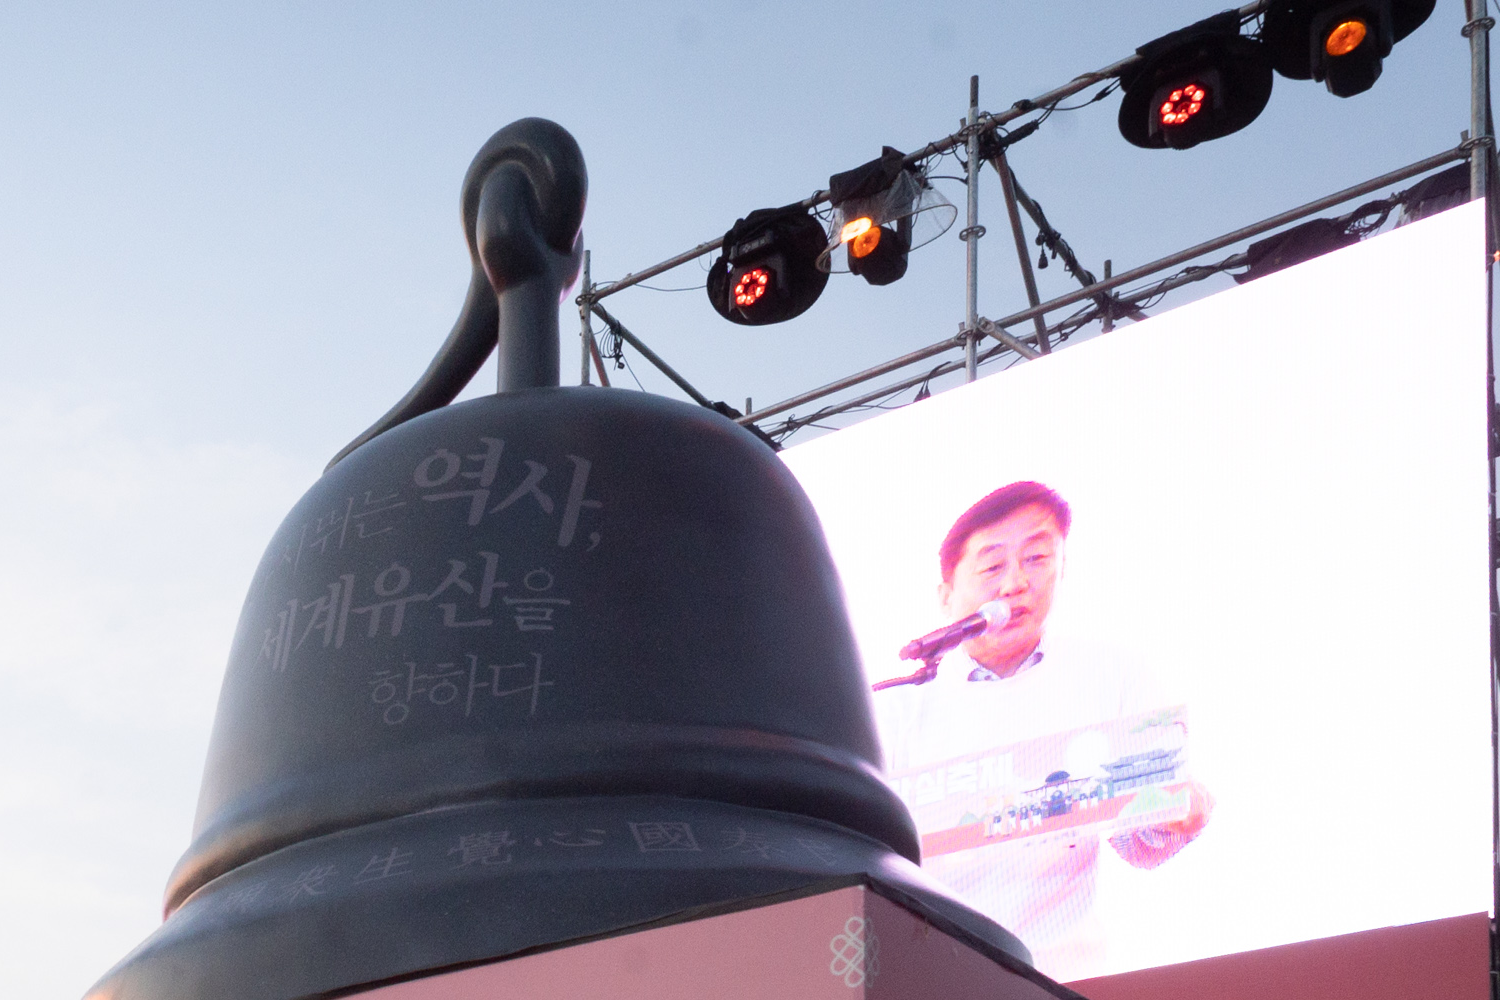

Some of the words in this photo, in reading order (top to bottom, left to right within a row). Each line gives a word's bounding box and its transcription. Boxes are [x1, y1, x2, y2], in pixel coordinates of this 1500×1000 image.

[310, 490, 407, 554] 뛰는
[413, 438, 602, 551] 역사,
[257, 552, 570, 671] 세계유산을
[368, 652, 554, 725] 향하다
